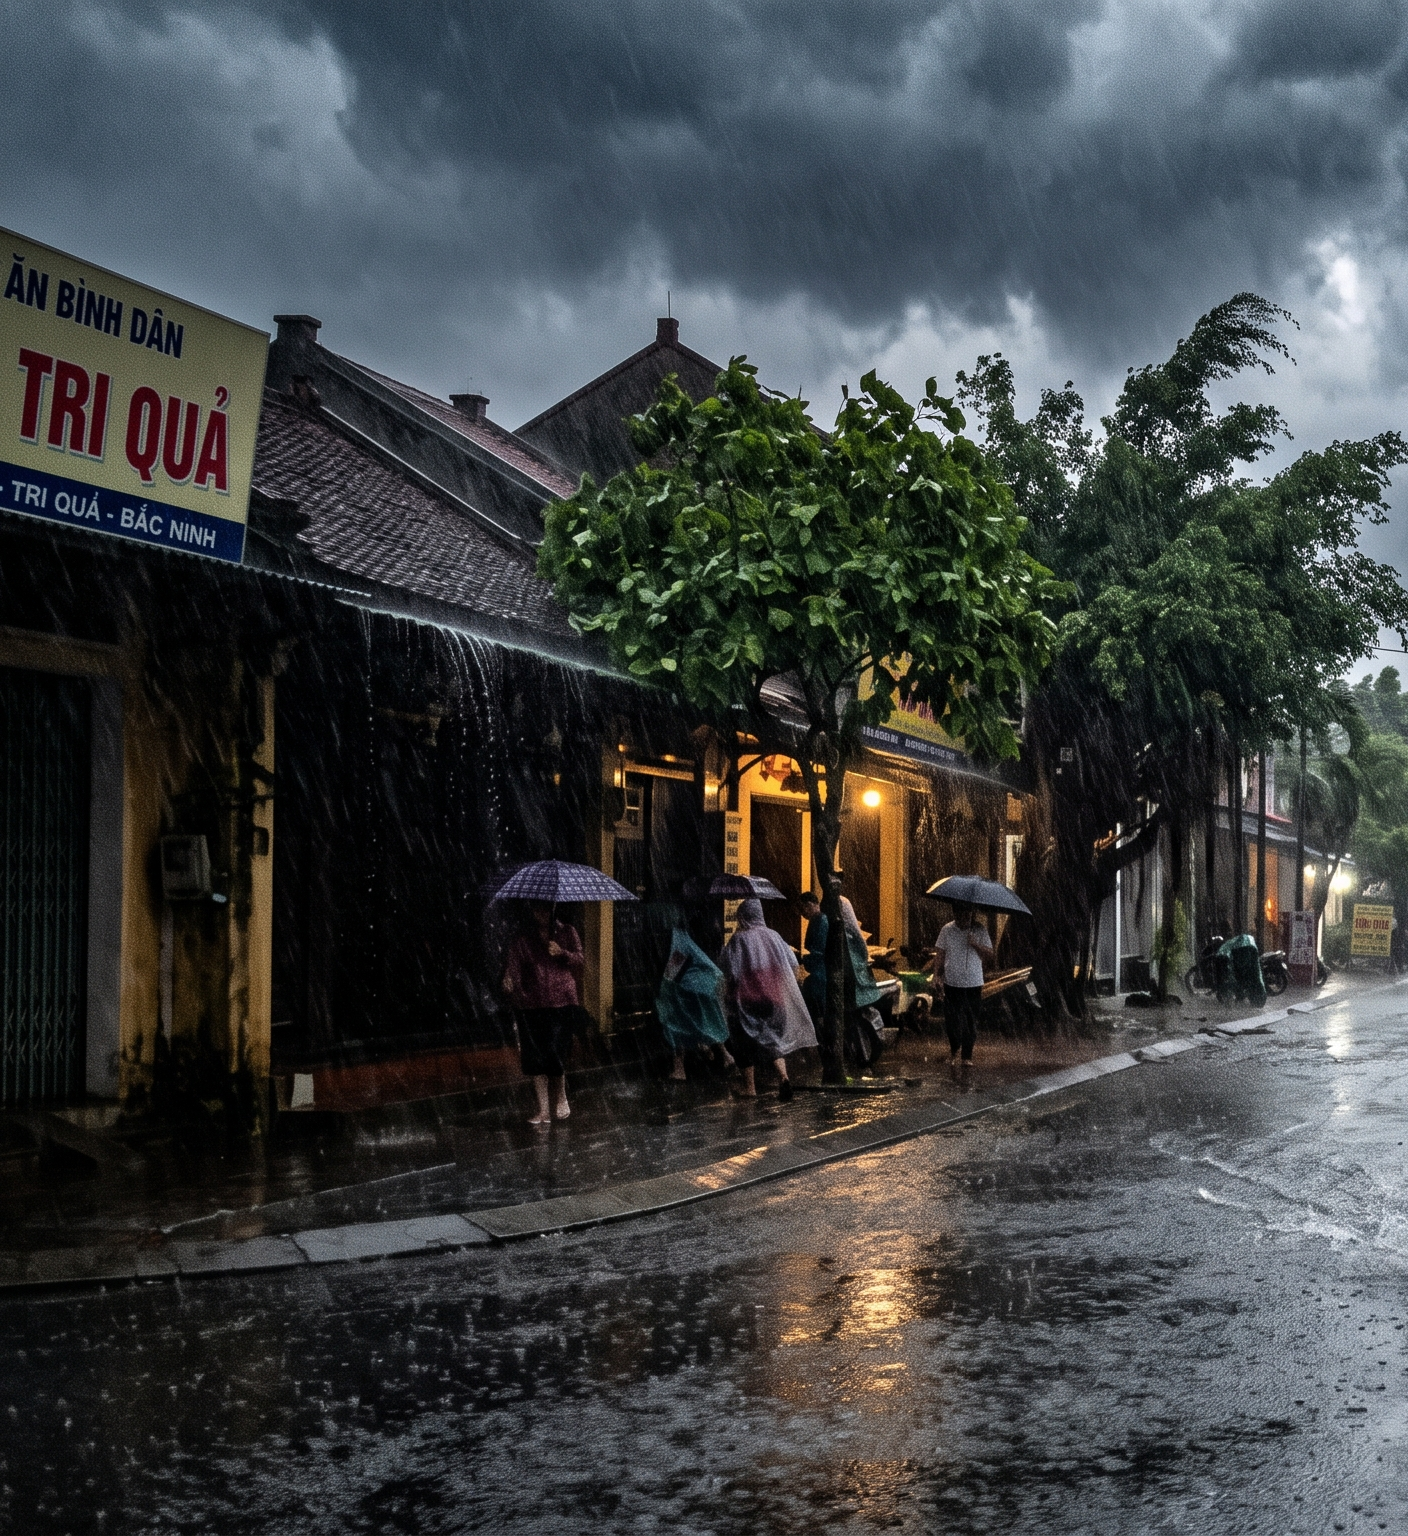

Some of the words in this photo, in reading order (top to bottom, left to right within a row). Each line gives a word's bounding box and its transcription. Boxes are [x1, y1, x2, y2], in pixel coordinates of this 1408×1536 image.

[4, 253, 49, 312] ĂN
[56, 277, 123, 338] BÌNH
[129, 307, 185, 360] DÂN
[18, 347, 111, 460] TRI
[125, 386, 230, 494] QUẢ
[12, 480, 47, 508] TRI
[54, 491, 100, 522] QUẢ
[120, 503, 164, 536] BẮC
[169, 519, 216, 549] NINH
